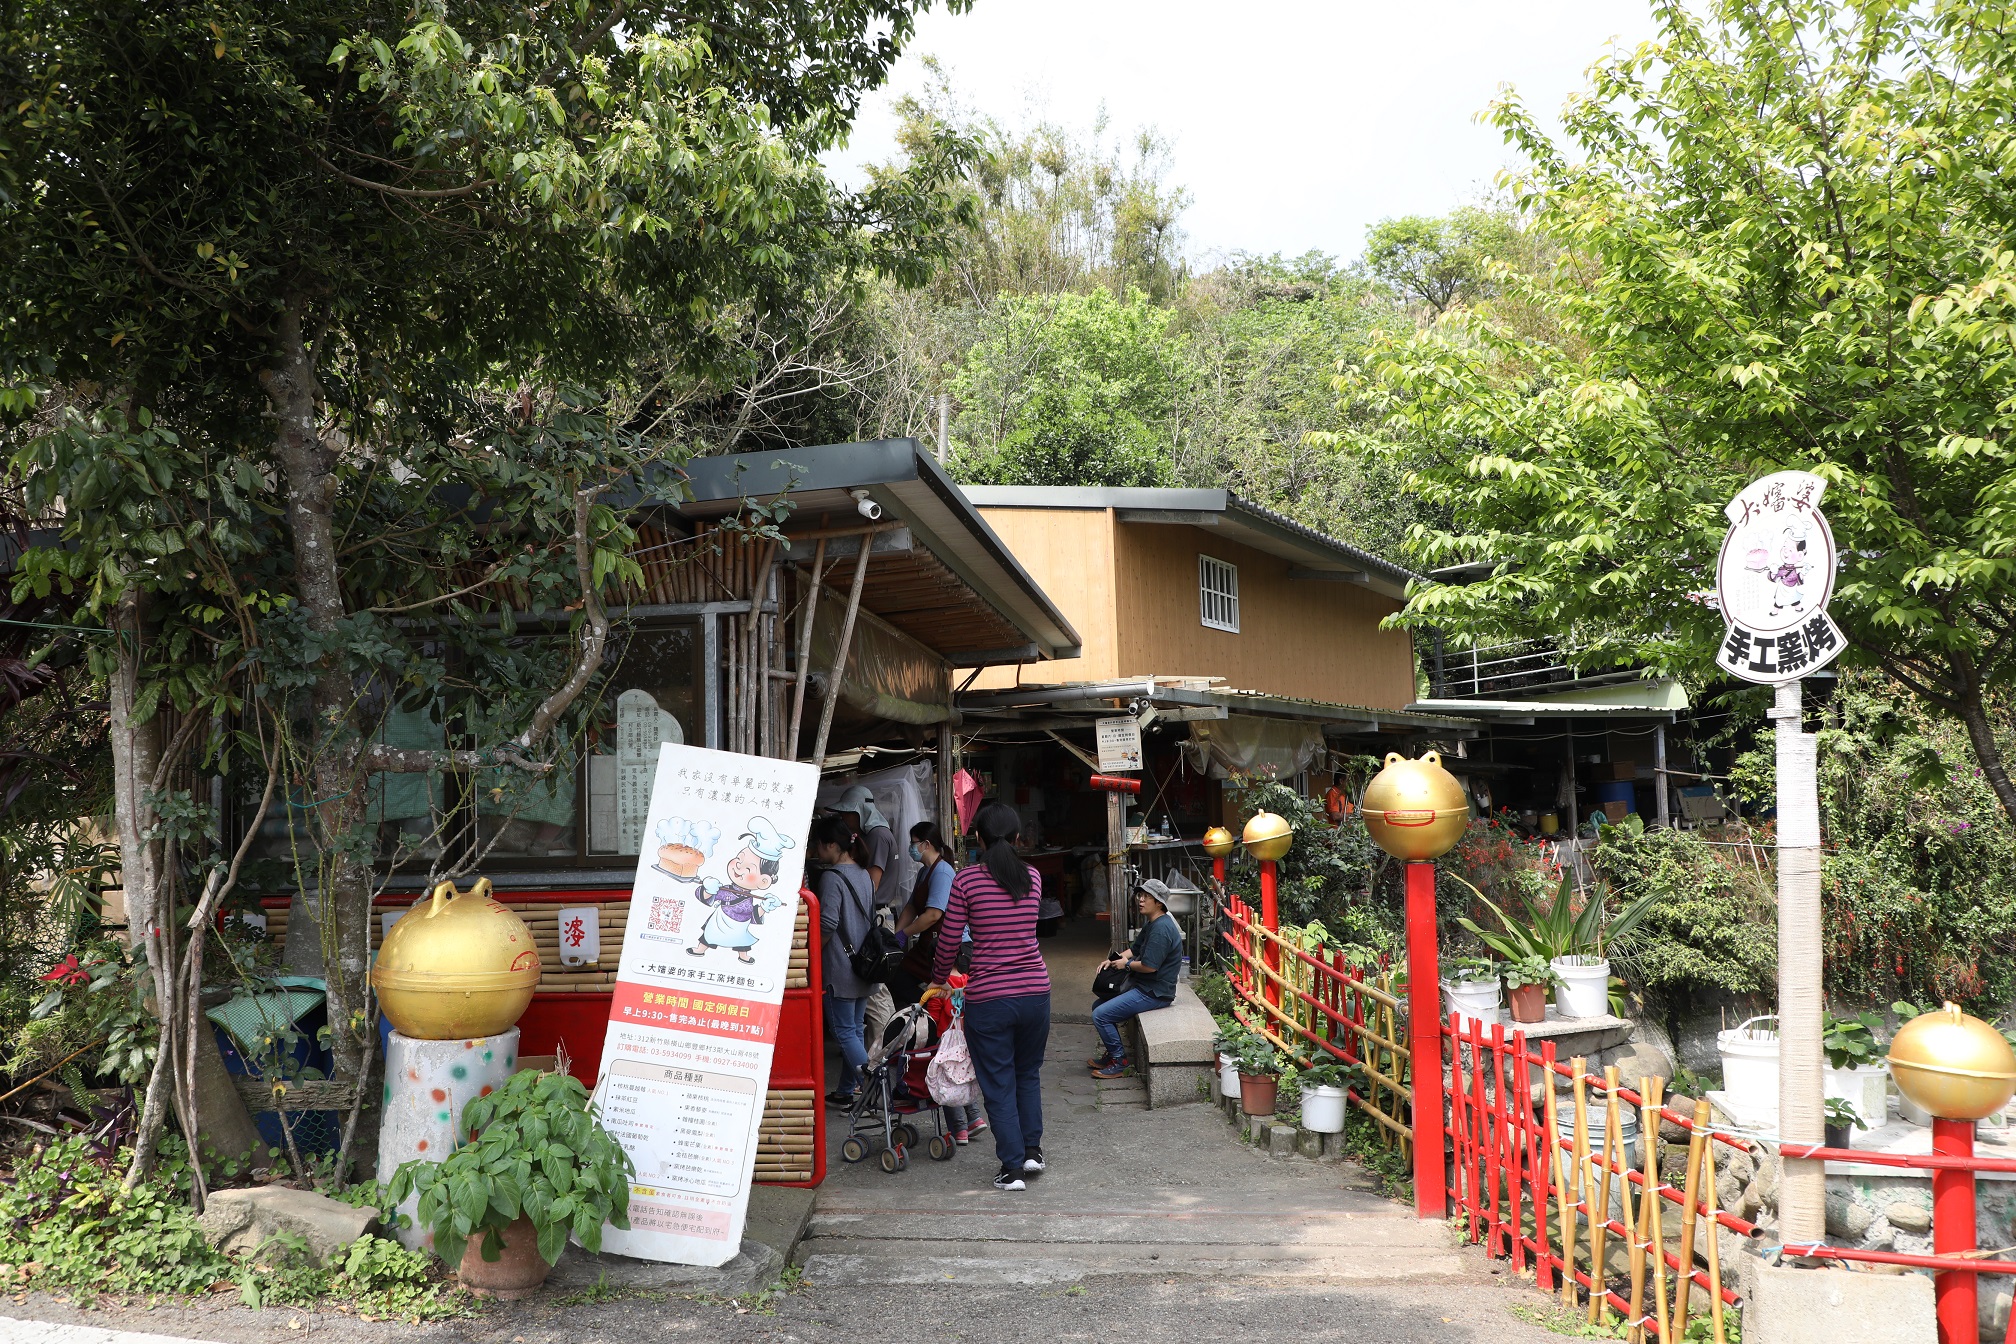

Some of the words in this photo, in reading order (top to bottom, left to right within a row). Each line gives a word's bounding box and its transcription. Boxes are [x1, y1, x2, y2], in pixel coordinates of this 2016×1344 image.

[1725, 613, 1838, 675] 手工窯烤
[677, 767, 794, 796] 我家沒有華麗的裝潢
[682, 786, 785, 811] 只有濃濃的人情味
[564, 916, 585, 947] 婆
[643, 991, 690, 1009] 營業時間
[692, 999, 750, 1018] 國定例假日
[650, 1048, 692, 1061] 03-5934099
[713, 1057, 759, 1071] 0927-634000
[664, 1069, 703, 1084] 商品種類
